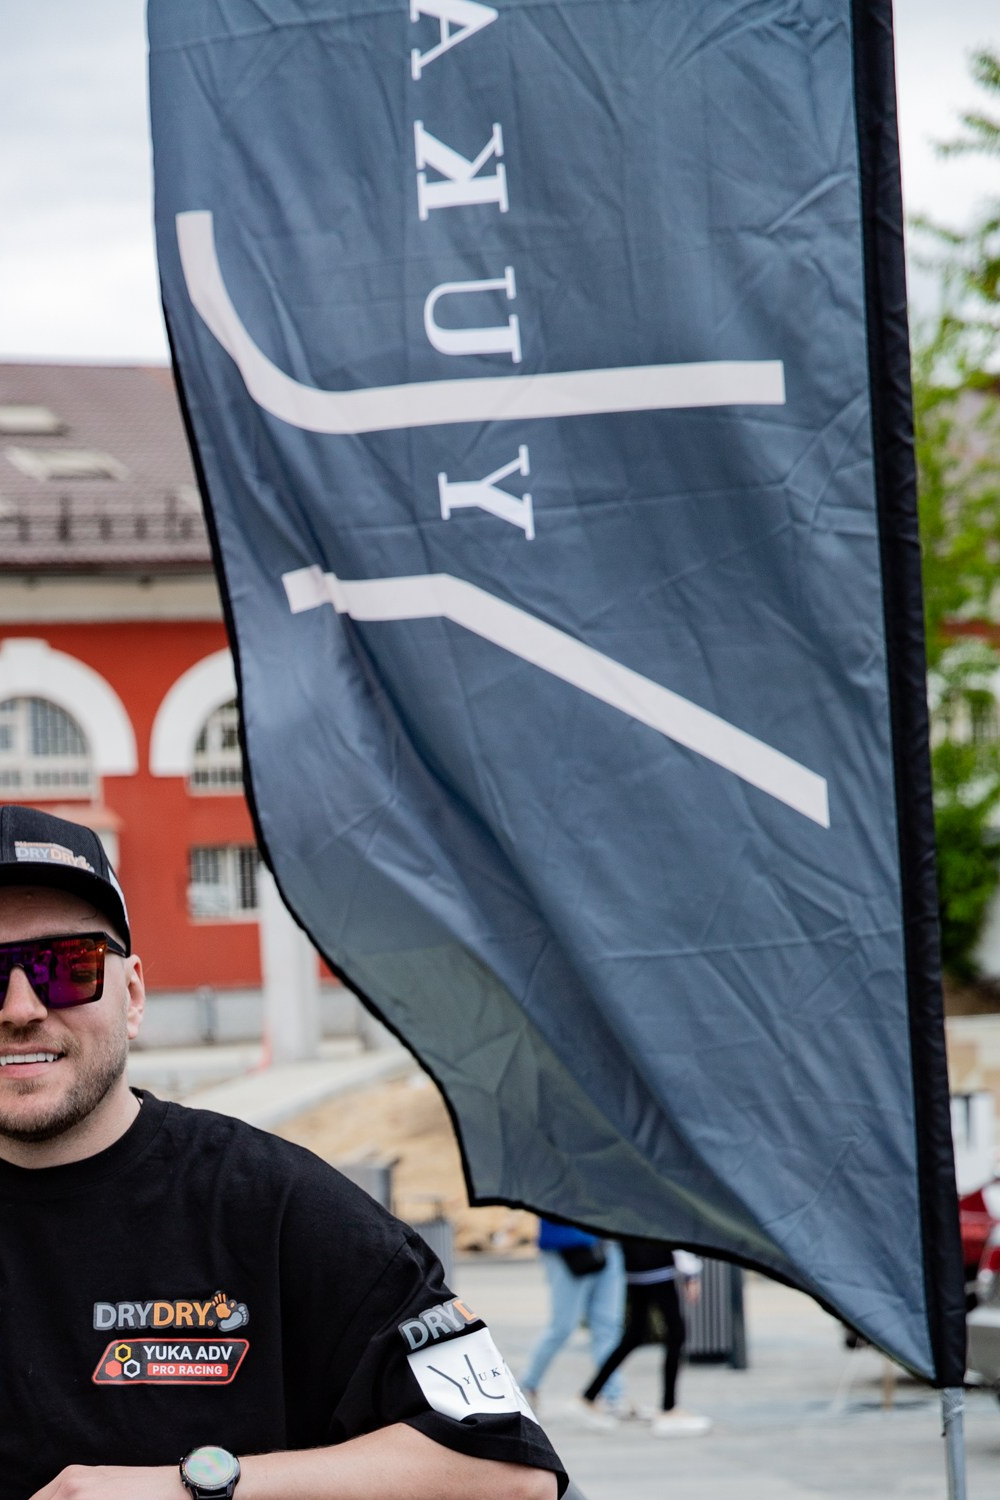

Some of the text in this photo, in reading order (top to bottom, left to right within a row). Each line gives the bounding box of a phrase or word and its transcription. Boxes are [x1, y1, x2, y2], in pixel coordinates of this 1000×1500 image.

[143, 1346, 233, 1361] YUKA ADV
[152, 1365, 223, 1375] PRO RACING
